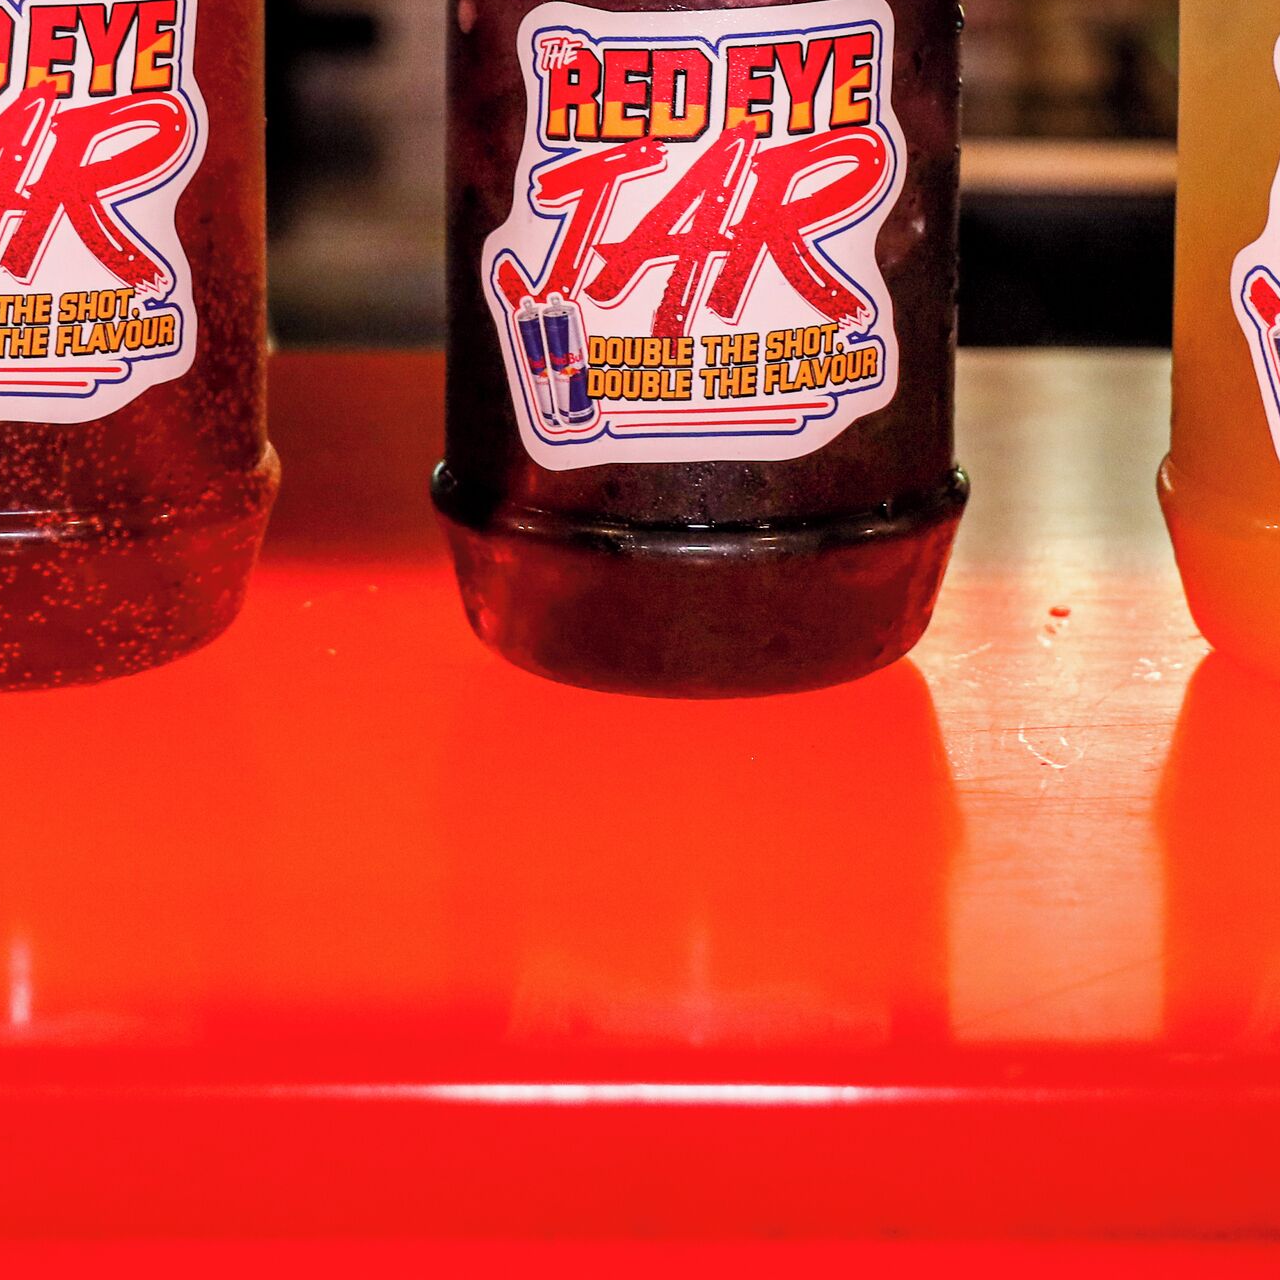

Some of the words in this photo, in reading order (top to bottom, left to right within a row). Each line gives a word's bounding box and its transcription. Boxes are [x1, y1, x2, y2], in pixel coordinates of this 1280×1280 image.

[538, 37, 582, 70] THE
[546, 47, 713, 142] RED
[723, 32, 875, 139] EYE
[497, 120, 889, 336] JAR
[56, 314, 174, 356] FLAVOUR
[587, 334, 693, 367] DOUBLE
[701, 331, 761, 366] THE
[587, 366, 692, 401] DOUBLE
[701, 365, 758, 399] THE
[764, 347, 878, 394] FLAVOUR
